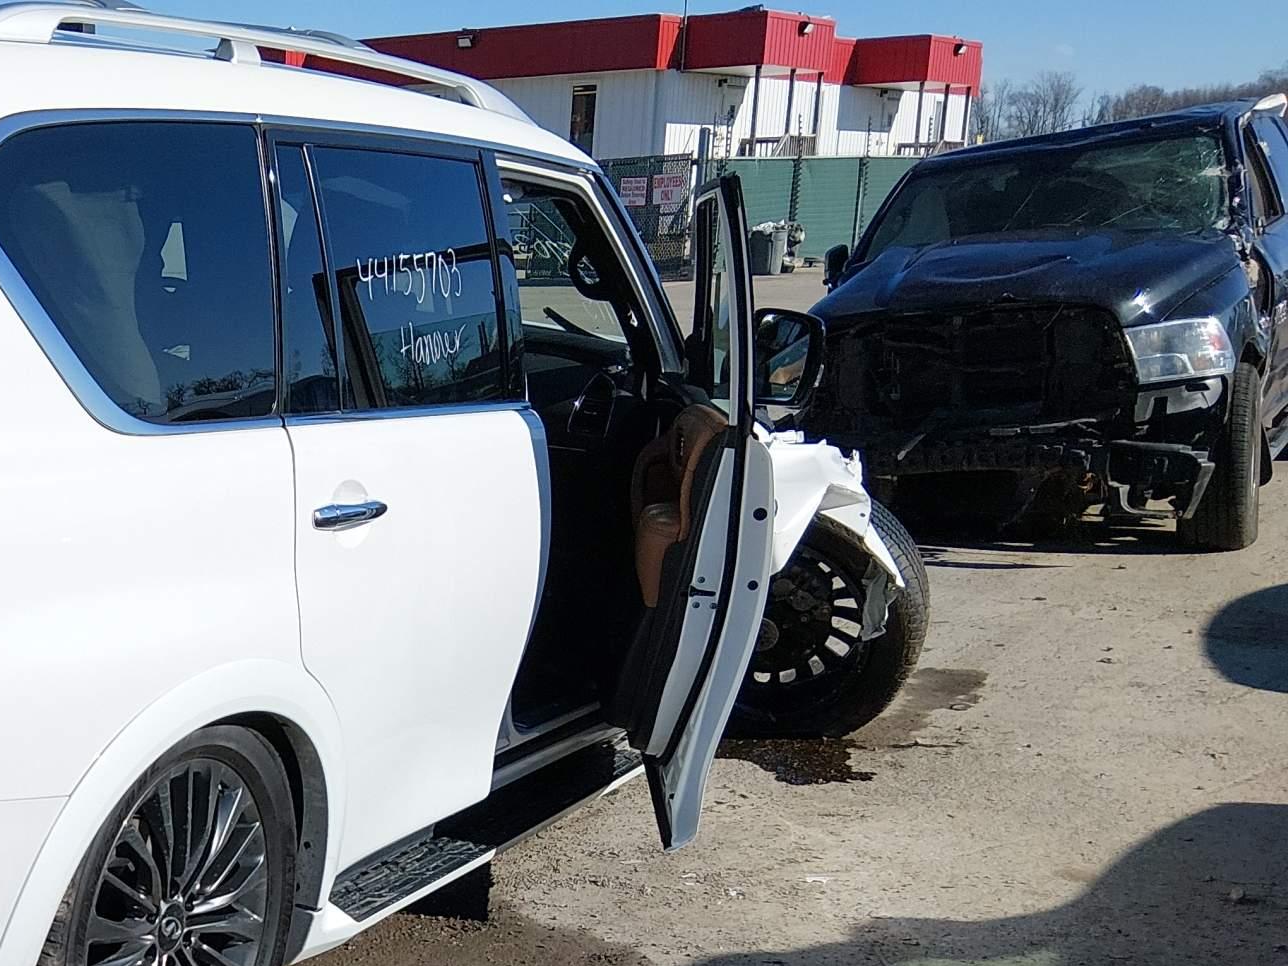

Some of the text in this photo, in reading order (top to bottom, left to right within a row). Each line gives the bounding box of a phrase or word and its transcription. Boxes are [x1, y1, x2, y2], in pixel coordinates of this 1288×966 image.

[654, 176, 682, 189] EMPLOYEES
[661, 190, 674, 201] ONLY
[356, 248, 462, 304] 44155703
